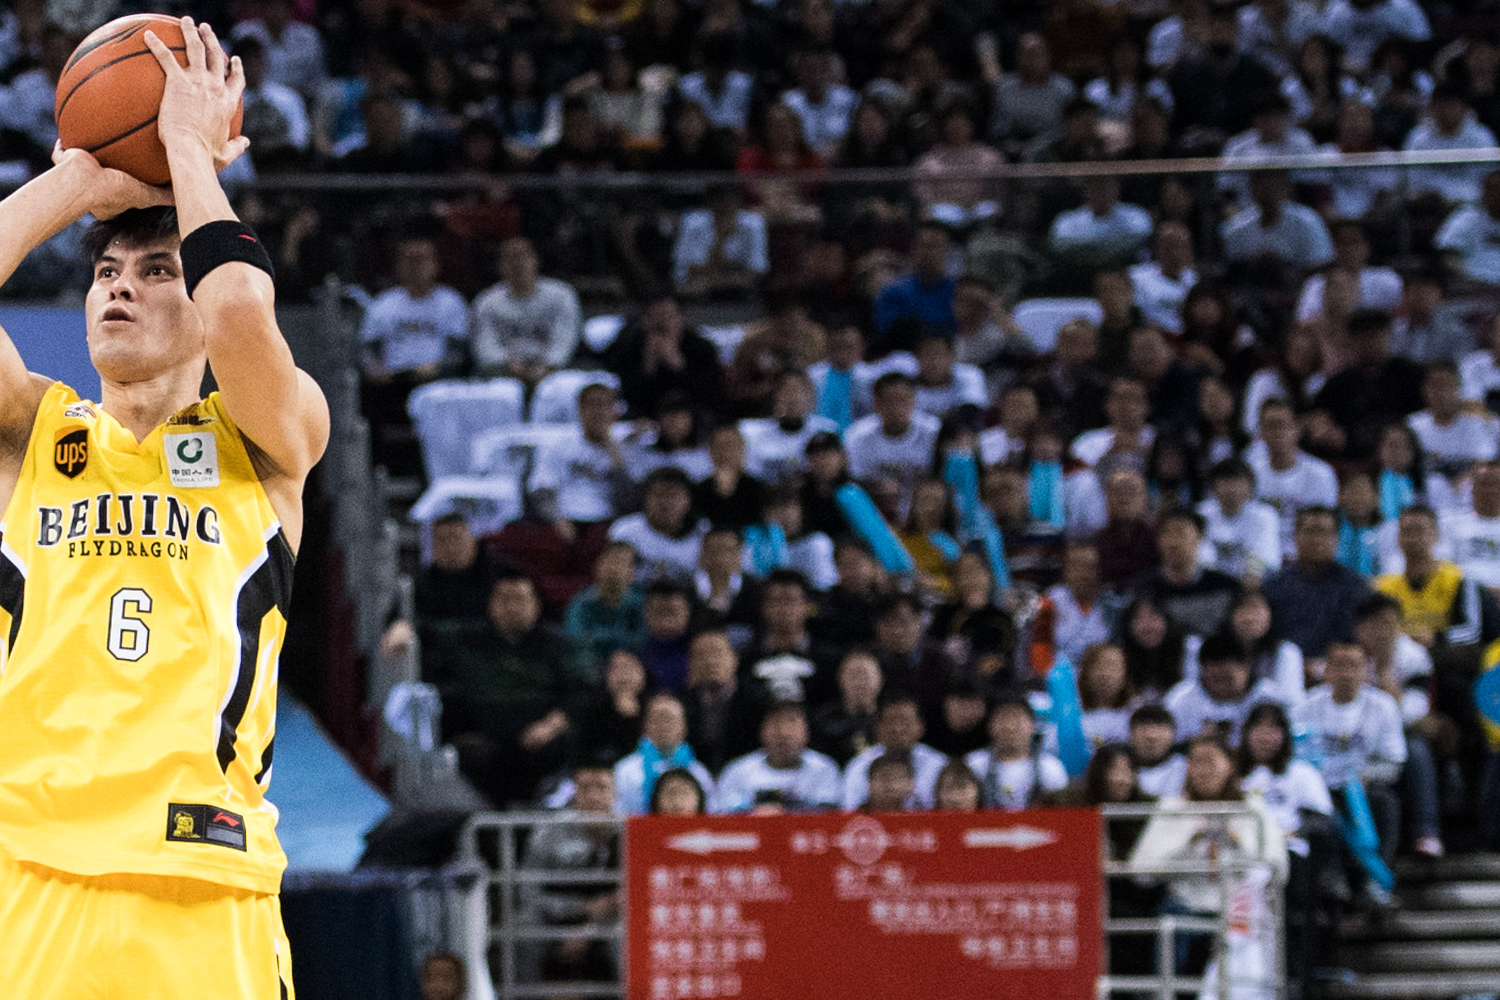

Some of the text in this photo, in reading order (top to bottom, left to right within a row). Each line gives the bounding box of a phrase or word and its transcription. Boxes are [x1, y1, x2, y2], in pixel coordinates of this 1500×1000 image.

[56, 441, 87, 472] ups
[171, 467, 213, 477] 中国人寿
[36, 493, 221, 546] BEIJING
[68, 540, 189, 561] FLYDRAGON
[106, 587, 153, 662] 6
